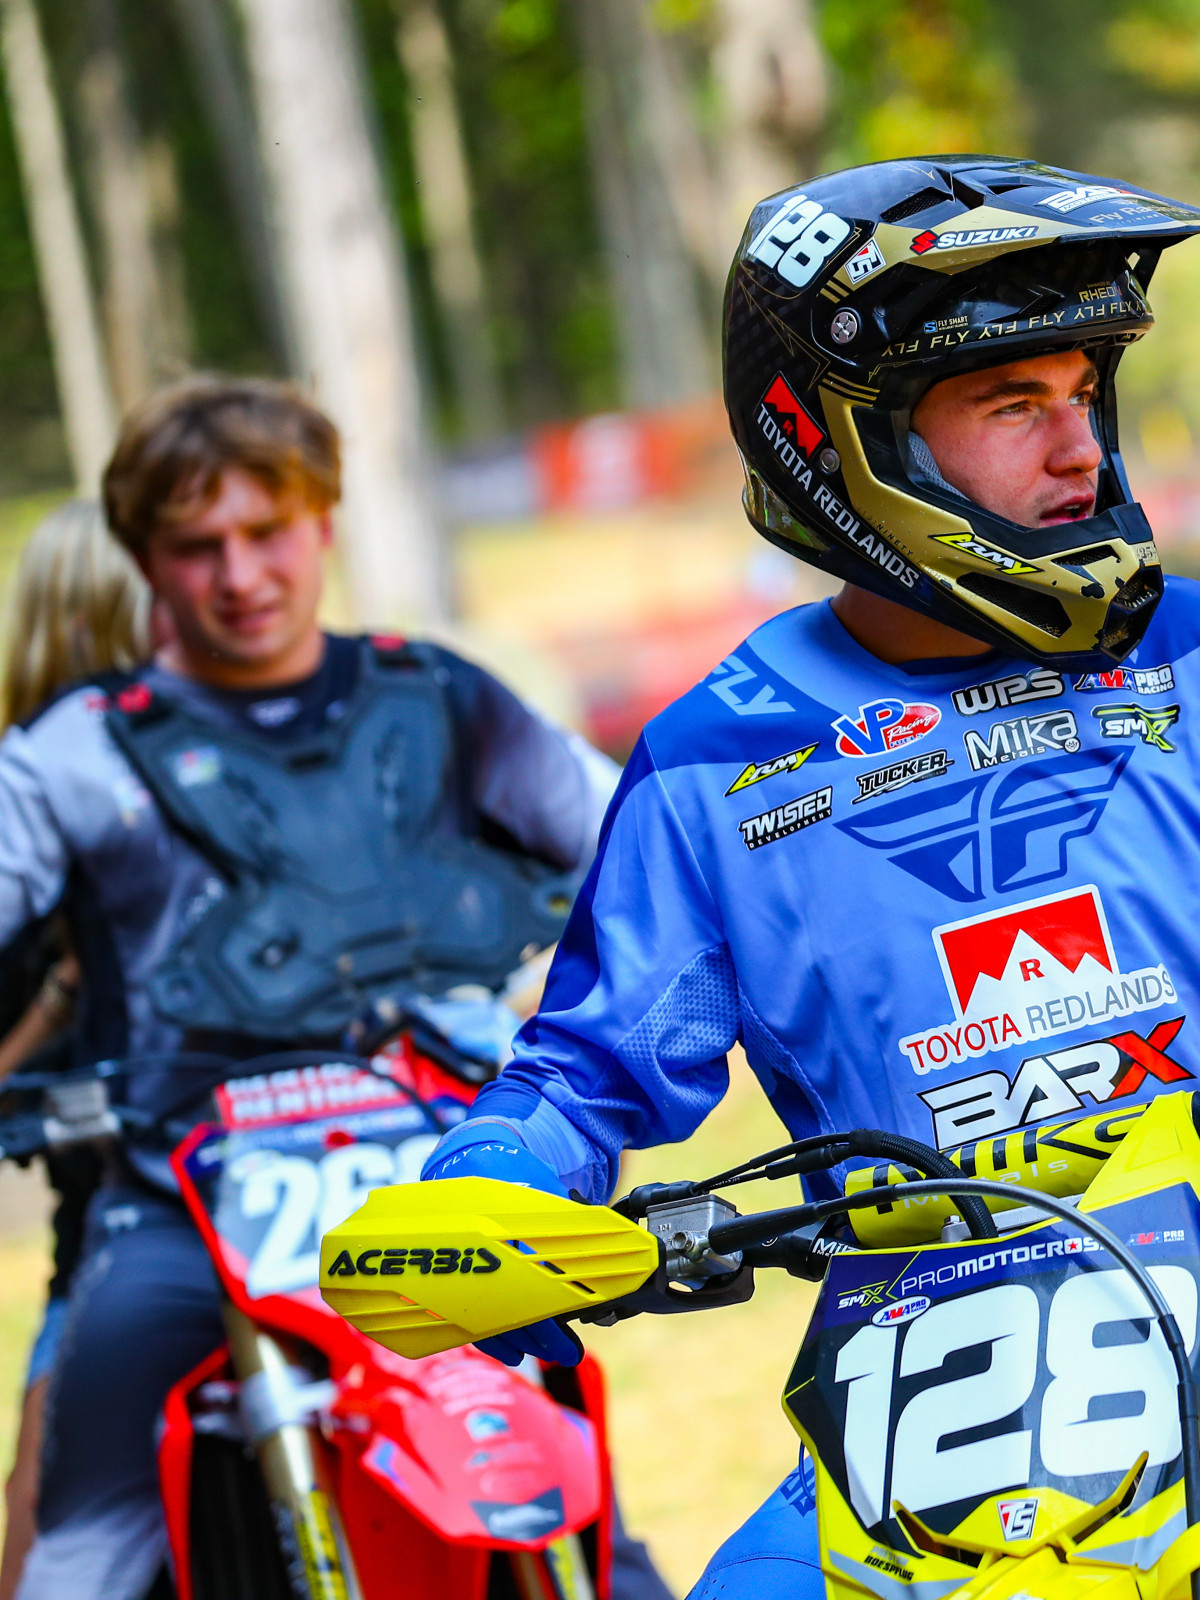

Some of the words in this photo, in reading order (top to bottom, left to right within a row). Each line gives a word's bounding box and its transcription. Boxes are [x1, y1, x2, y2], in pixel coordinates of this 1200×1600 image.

[747, 194, 851, 287] 128
[937, 225, 1037, 250] SUZUKI
[930, 330, 970, 348] FLY
[1029, 310, 1066, 329] FLY
[1110, 302, 1132, 314] FLY
[938, 319, 948, 328] FLY
[949, 316, 968, 326] SMART
[756, 403, 814, 492] TOYOTA
[813, 485, 920, 589] REDLANDS
[930, 532, 1043, 575] ARMY
[707, 654, 797, 716] FLY
[954, 668, 1064, 716] WPS
[1075, 669, 1137, 692] AMA
[1134, 666, 1173, 686] PRO
[1137, 682, 1175, 694] RACING
[833, 699, 906, 757] VP
[886, 711, 940, 742] Racing
[888, 732, 925, 749] FUELS
[965, 711, 1077, 771] Mika
[1101, 709, 1177, 751] SMX
[724, 742, 819, 797] ARMY
[861, 750, 947, 794] TUCKER
[983, 745, 1046, 768] Metals
[748, 808, 832, 850] DEVELOPMENT
[1018, 958, 1045, 983] R
[906, 1012, 1022, 1069] TOYOTA
[1026, 969, 1175, 1035] REDLANDS
[916, 1015, 1197, 1151] BARX
[441, 1147, 474, 1174] FLY
[240, 1132, 448, 1299] 26
[1163, 1229, 1185, 1238] PRO
[327, 1246, 502, 1277] ACERBIS
[837, 1280, 886, 1309] SMX
[877, 1303, 911, 1324] AMA
[910, 1298, 927, 1308] PRO
[834, 1264, 1198, 1530] 128
